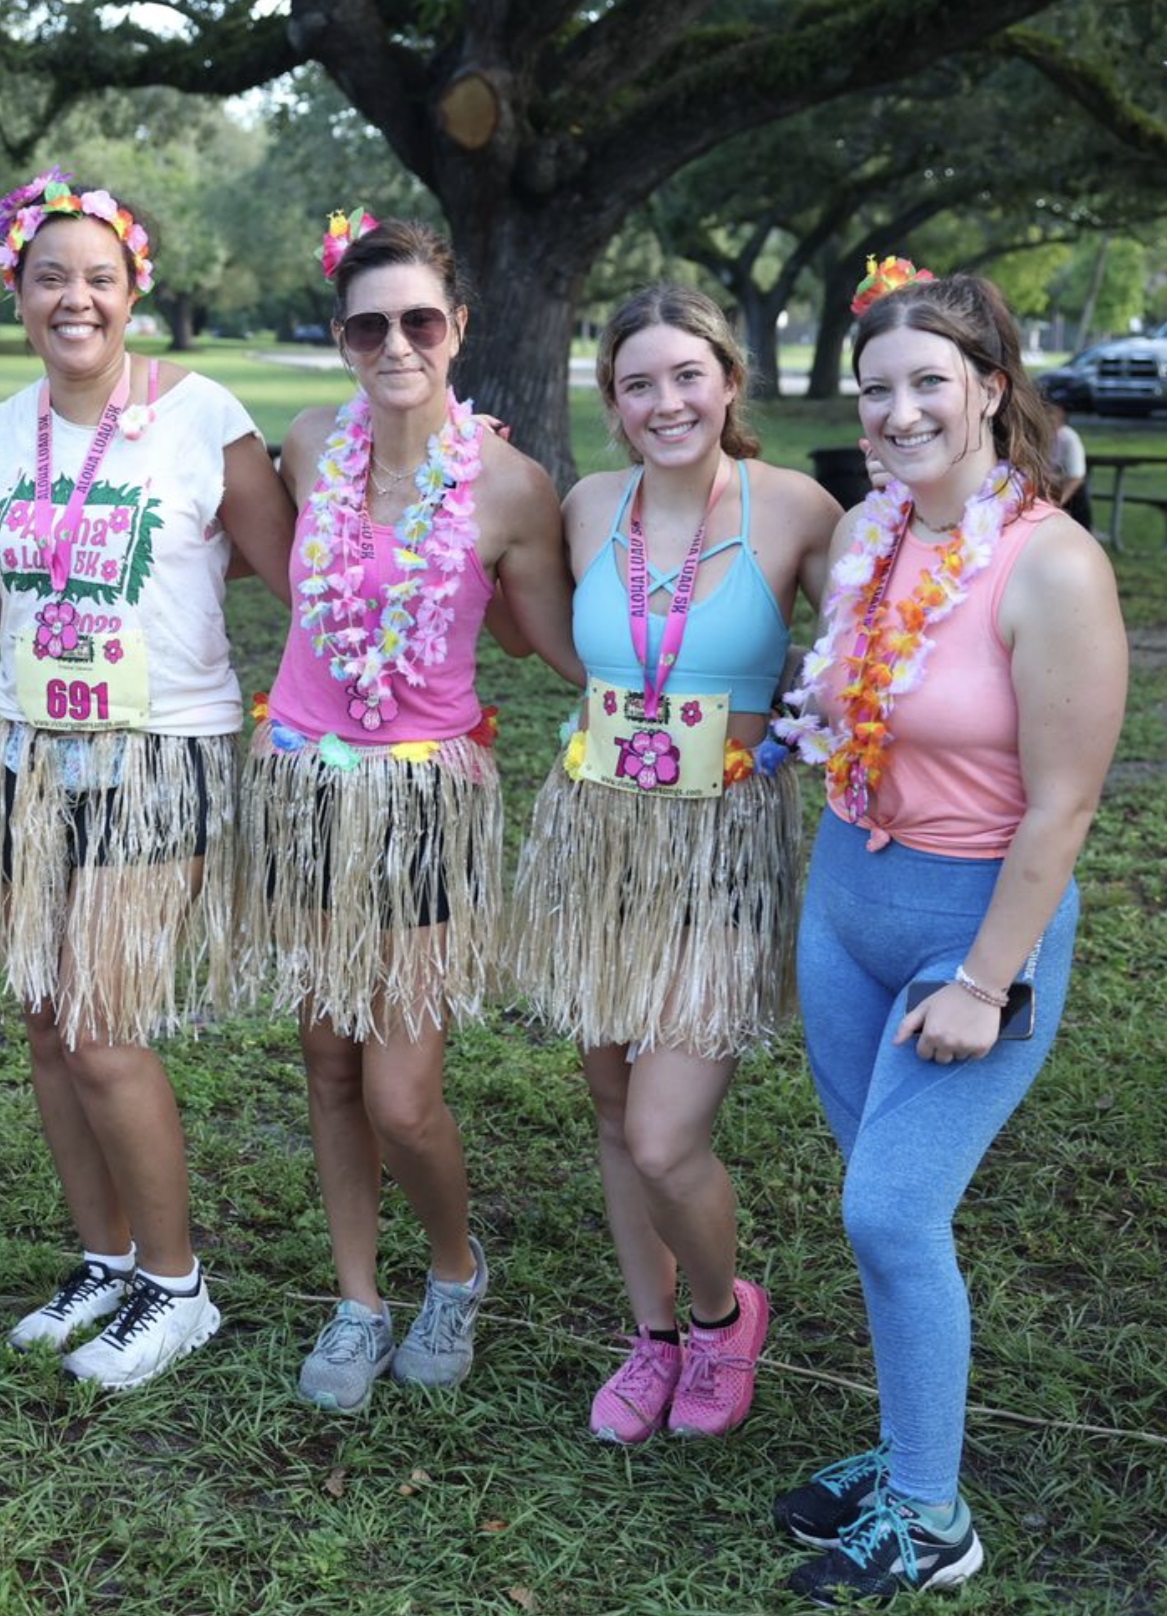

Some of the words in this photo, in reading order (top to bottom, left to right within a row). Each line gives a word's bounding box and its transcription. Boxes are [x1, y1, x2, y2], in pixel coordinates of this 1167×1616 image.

[76, 455, 99, 494] ALOHA
[92, 423, 113, 456] LUAU
[107, 404, 122, 423] 5K
[37, 461, 49, 499] ALOHA
[74, 550, 101, 578] 5K
[630, 538, 646, 573] LUAU
[677, 559, 696, 593] LUAU
[630, 577, 646, 618] ALOHA
[671, 595, 689, 614] 5K
[46, 678, 110, 720] 691
